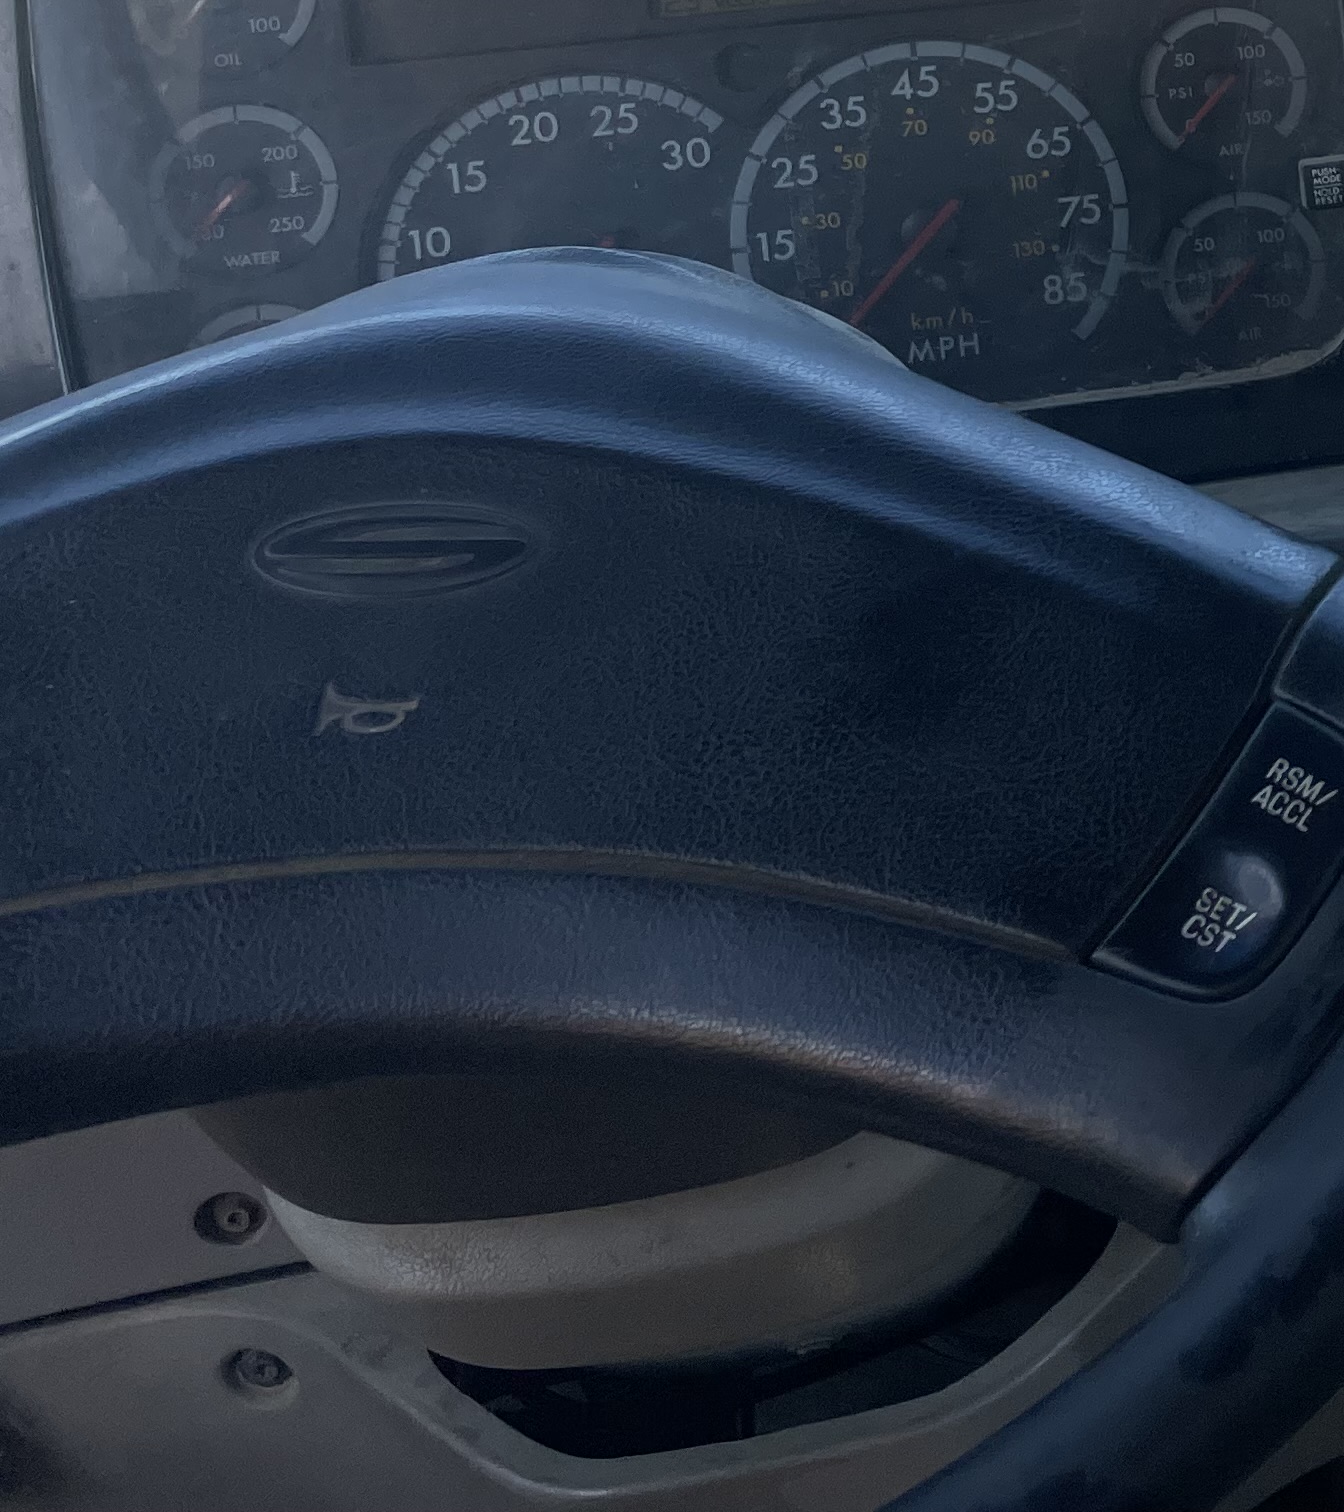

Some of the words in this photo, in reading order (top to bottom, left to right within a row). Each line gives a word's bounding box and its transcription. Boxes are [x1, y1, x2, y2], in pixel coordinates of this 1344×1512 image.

[249, 17, 281, 33] 100
[215, 54, 242, 68] OIL
[1174, 53, 1196, 68] 50
[1238, 45, 1266, 60] 100
[890, 65, 939, 101] 45
[973, 79, 1019, 114] 55
[1169, 88, 1193, 101] PSI
[590, 103, 638, 137] 25
[819, 95, 867, 130] 35
[1246, 111, 1272, 126] 150
[508, 111, 559, 146] 20
[902, 120, 928, 137] 70
[968, 130, 994, 145] 90
[1026, 126, 1071, 159] 65
[1219, 145, 1243, 157] AIR
[185, 154, 215, 170] 150
[262, 145, 297, 162] 200
[661, 138, 711, 171] 30
[841, 153, 867, 170] 50
[446, 160, 487, 194] 15
[771, 154, 819, 189] 25
[1010, 174, 1037, 192] 110
[1057, 193, 1101, 228] 75
[270, 216, 305, 233] 250
[815, 213, 841, 229] 30
[408, 227, 450, 260] 10
[1193, 237, 1215, 252] 50
[1257, 228, 1285, 243] 100
[756, 229, 796, 262] 15
[1012, 241, 1045, 258] 130
[224, 251, 281, 267] WATER
[832, 281, 854, 296] 10
[1043, 272, 1088, 305] 85
[910, 307, 974, 331] km/h
[907, 333, 981, 365] MPH
[1266, 757, 1338, 806] RSM/
[1251, 784, 1314, 833] ACCL
[1196, 887, 1257, 931] SET/
[1180, 914, 1237, 954] CST
